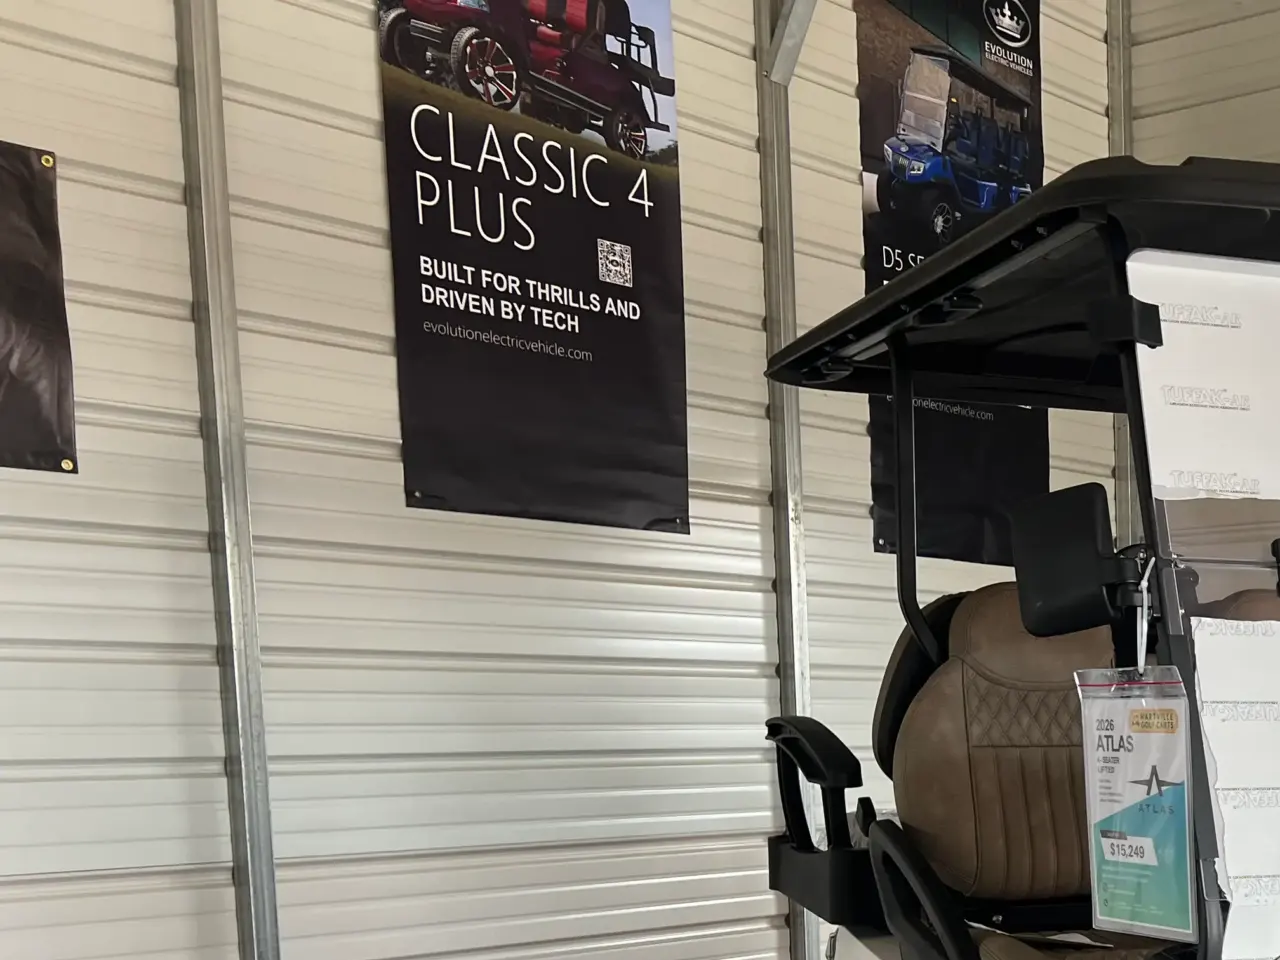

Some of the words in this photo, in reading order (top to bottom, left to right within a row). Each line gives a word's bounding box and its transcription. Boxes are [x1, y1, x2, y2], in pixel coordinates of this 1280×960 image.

[984, 41, 1033, 70] EVOLUTION
[1009, 62, 1034, 77] VEHICLES
[410, 103, 610, 207] CLASSIC
[627, 168, 654, 218] 4
[415, 171, 536, 251] PLUS
[882, 245, 904, 272] D5
[419, 255, 476, 286] BUILT
[481, 269, 522, 296] FOR
[525, 278, 601, 313] THRILLS
[604, 297, 642, 321] AND
[421, 283, 496, 317] DRIVEN
[500, 299, 526, 323] BY
[530, 306, 580, 333] TECH
[423, 319, 593, 362] evolutionelectricvehicle.com
[1096, 718, 1115, 732] 2026
[1140, 712, 1174, 721] HARTVILLE
[1156, 721, 1175, 730] CARTS
[1096, 734, 1134, 753] ATLAS
[1138, 803, 1175, 815] ATLAS
[1110, 842, 1145, 859] $15,249
